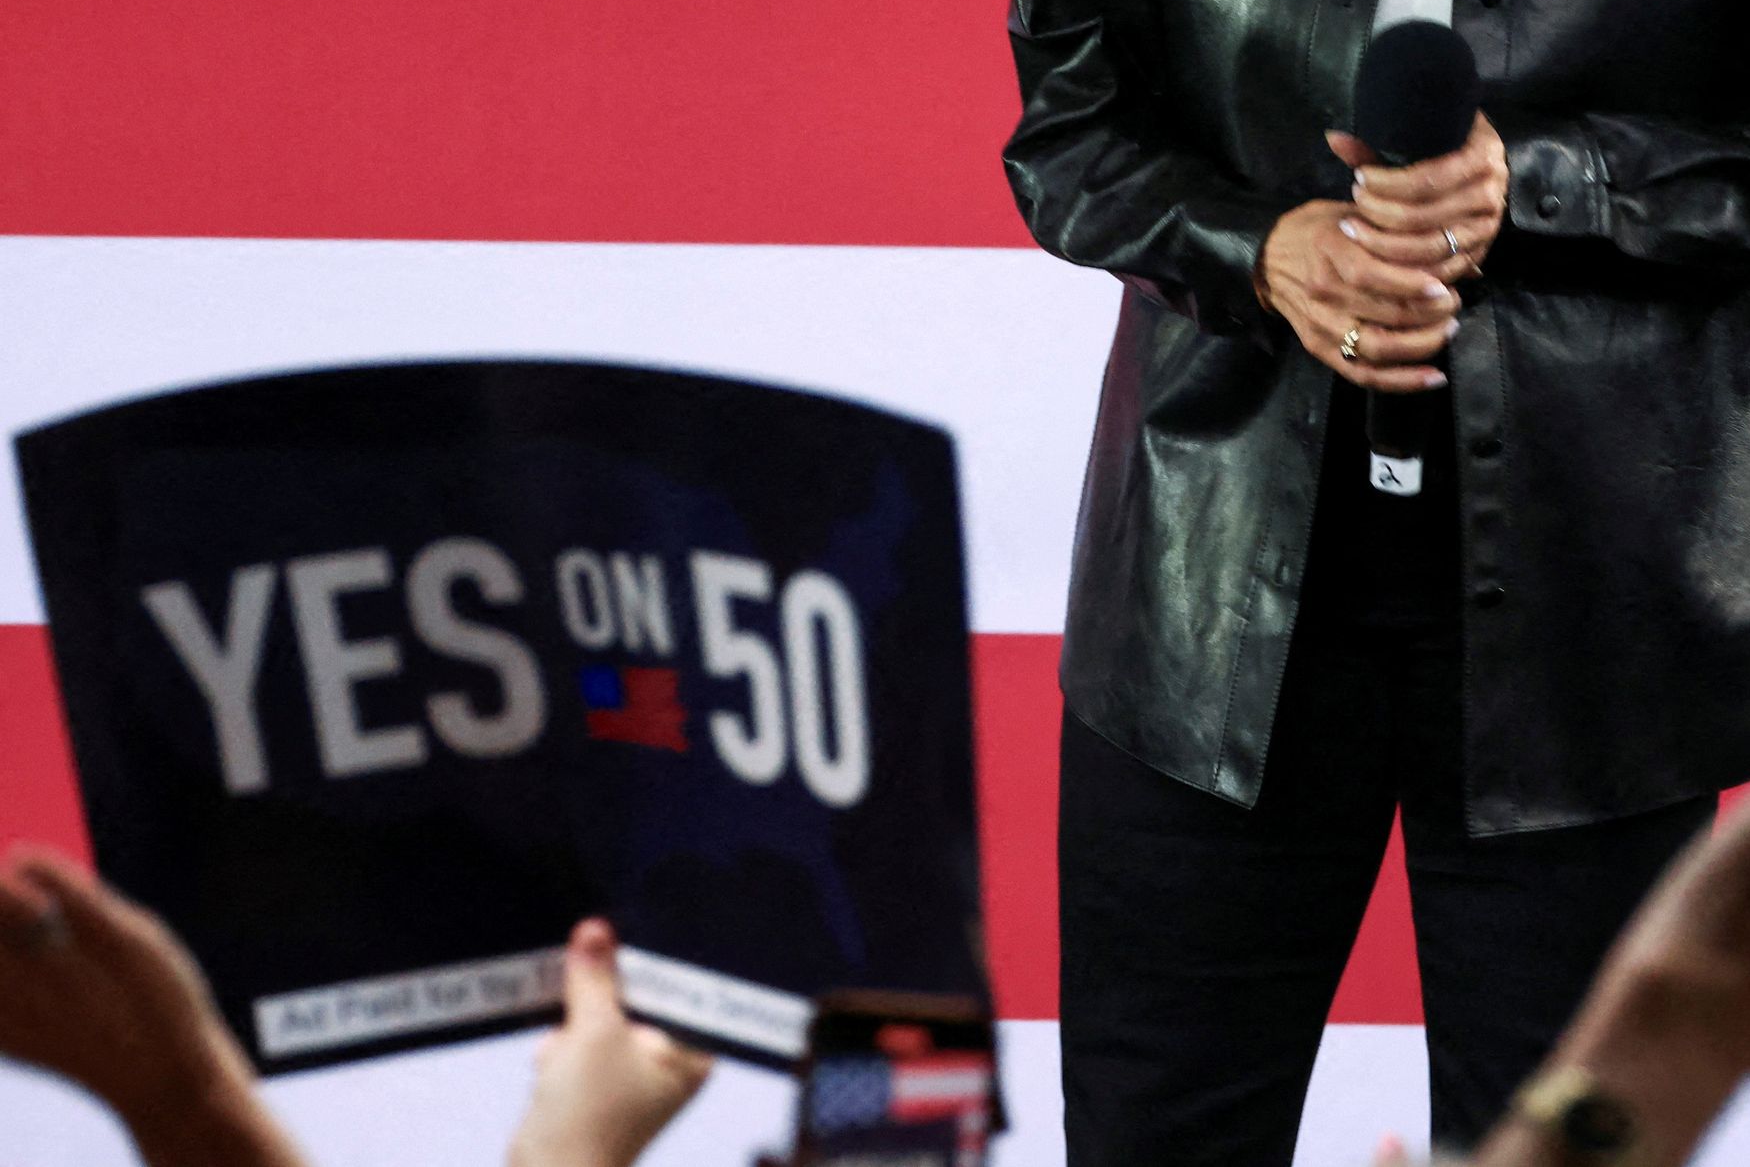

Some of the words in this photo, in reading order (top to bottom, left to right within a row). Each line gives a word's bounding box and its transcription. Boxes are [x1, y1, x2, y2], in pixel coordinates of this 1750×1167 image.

[140, 536, 549, 797] YES
[555, 547, 675, 657] ON
[690, 549, 871, 808] 50
